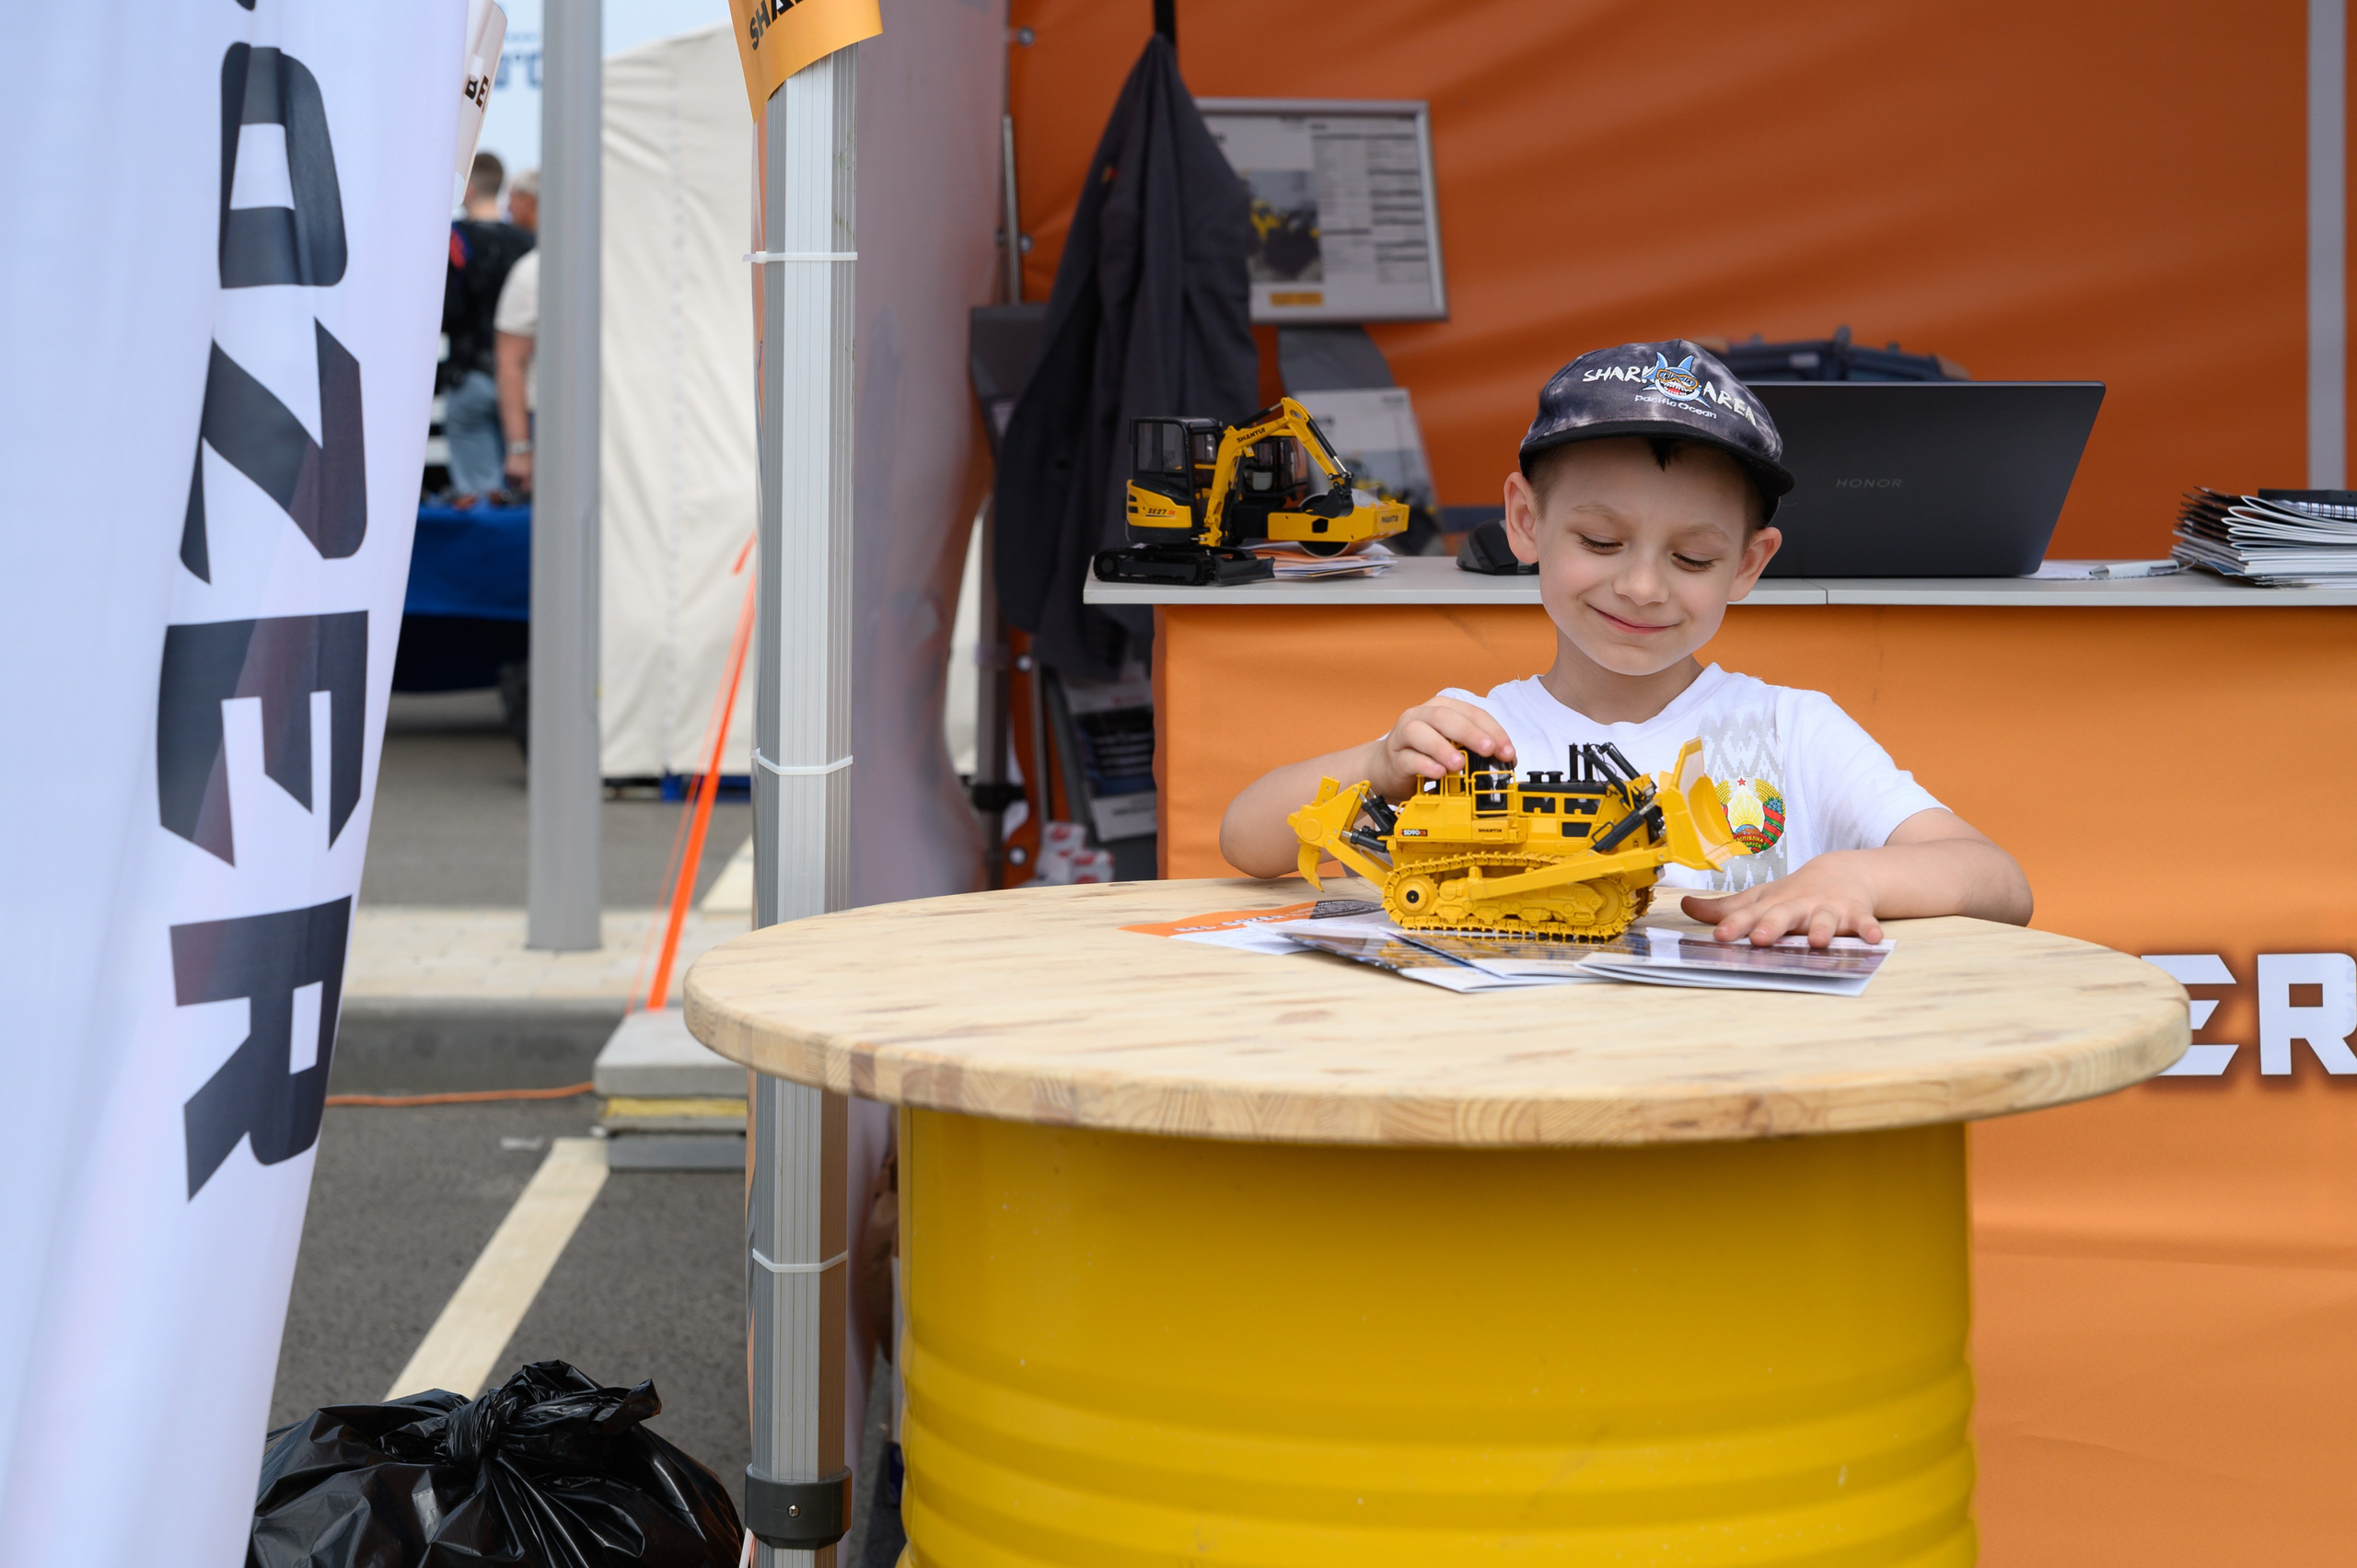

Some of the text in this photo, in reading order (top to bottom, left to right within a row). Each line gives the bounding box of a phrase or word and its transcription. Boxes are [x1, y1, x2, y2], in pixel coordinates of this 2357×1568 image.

[749, 0, 804, 51] SHA
[1703, 380, 1757, 426] AREA
[1237, 427, 1266, 444] SHANTUI
[1836, 479, 1902, 488] HONOR
[1147, 507, 1167, 516] SE27
[2141, 952, 2357, 1075] ER
